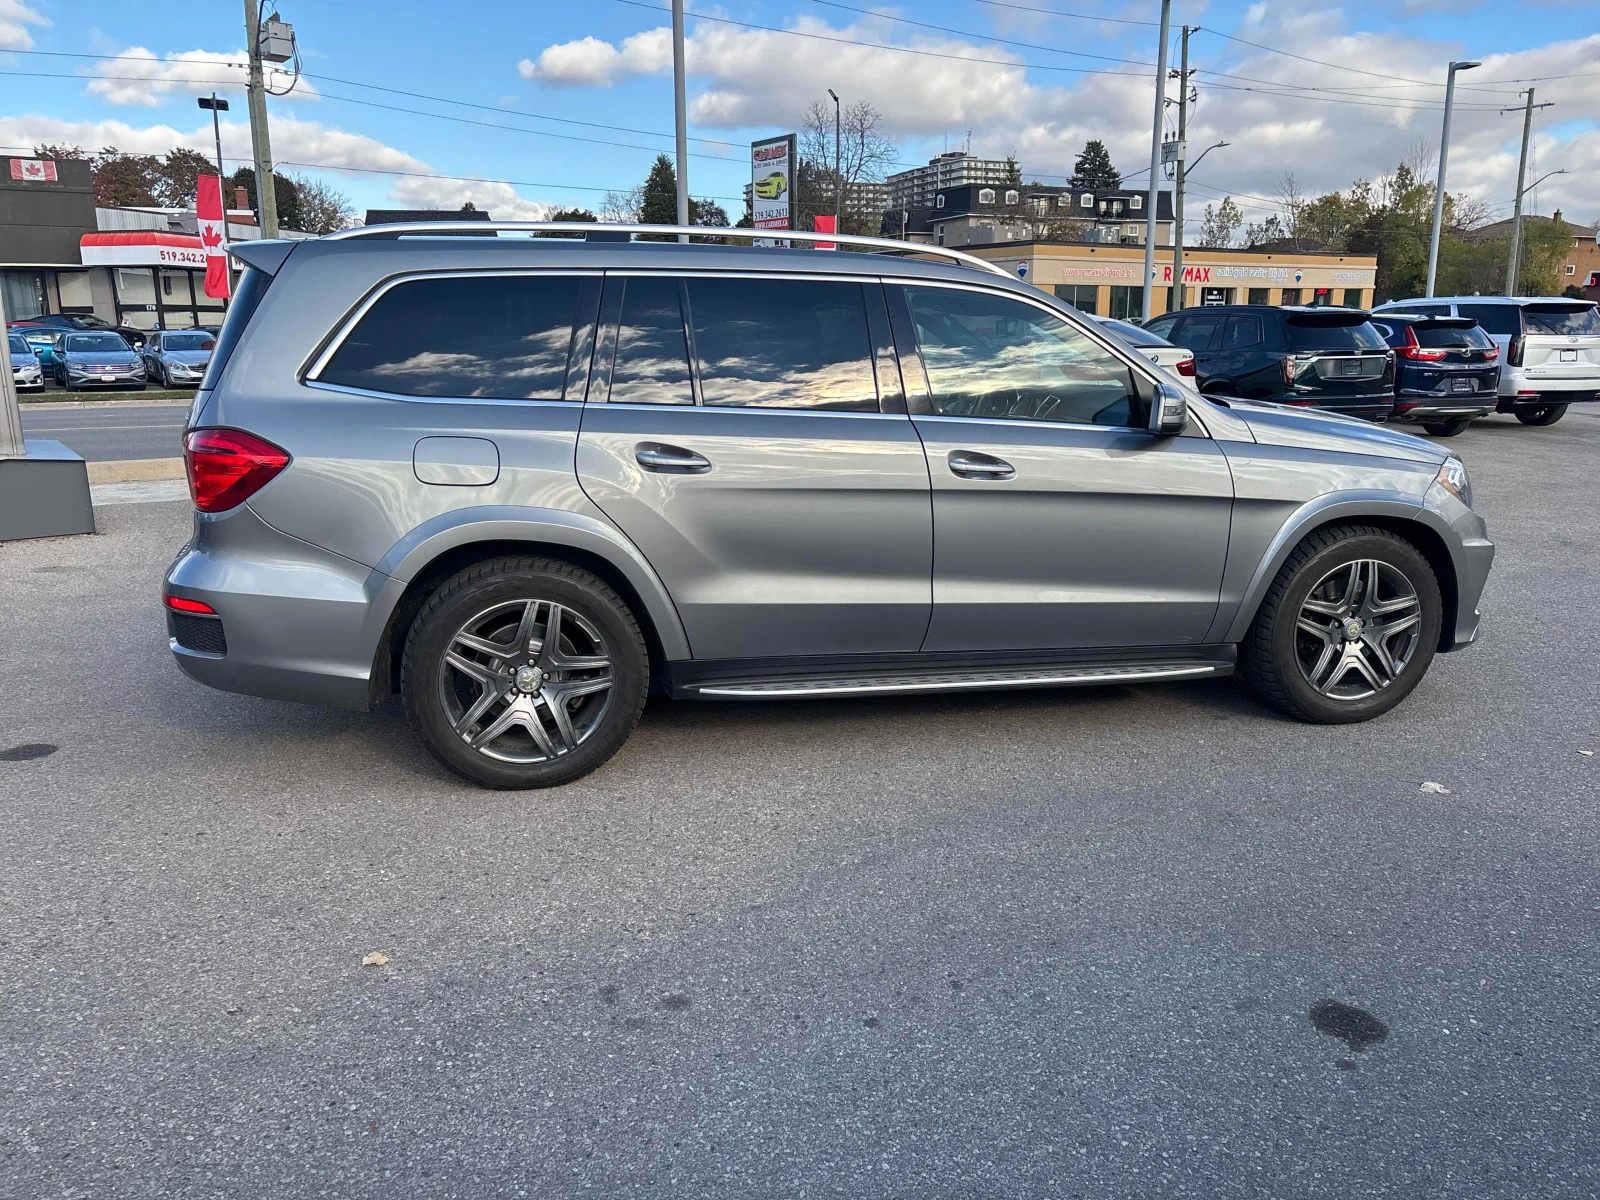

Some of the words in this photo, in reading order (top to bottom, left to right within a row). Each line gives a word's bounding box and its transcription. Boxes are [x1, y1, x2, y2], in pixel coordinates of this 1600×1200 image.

[755, 207, 788, 220] 519.342.2613
[160, 250, 207, 263] 519.342.2
[1063, 267, 1135, 279] www.remaxsolidgold.biz
[1217, 266, 1233, 276] solid
[1234, 267, 1248, 279] gold
[1249, 267, 1267, 279] realty
